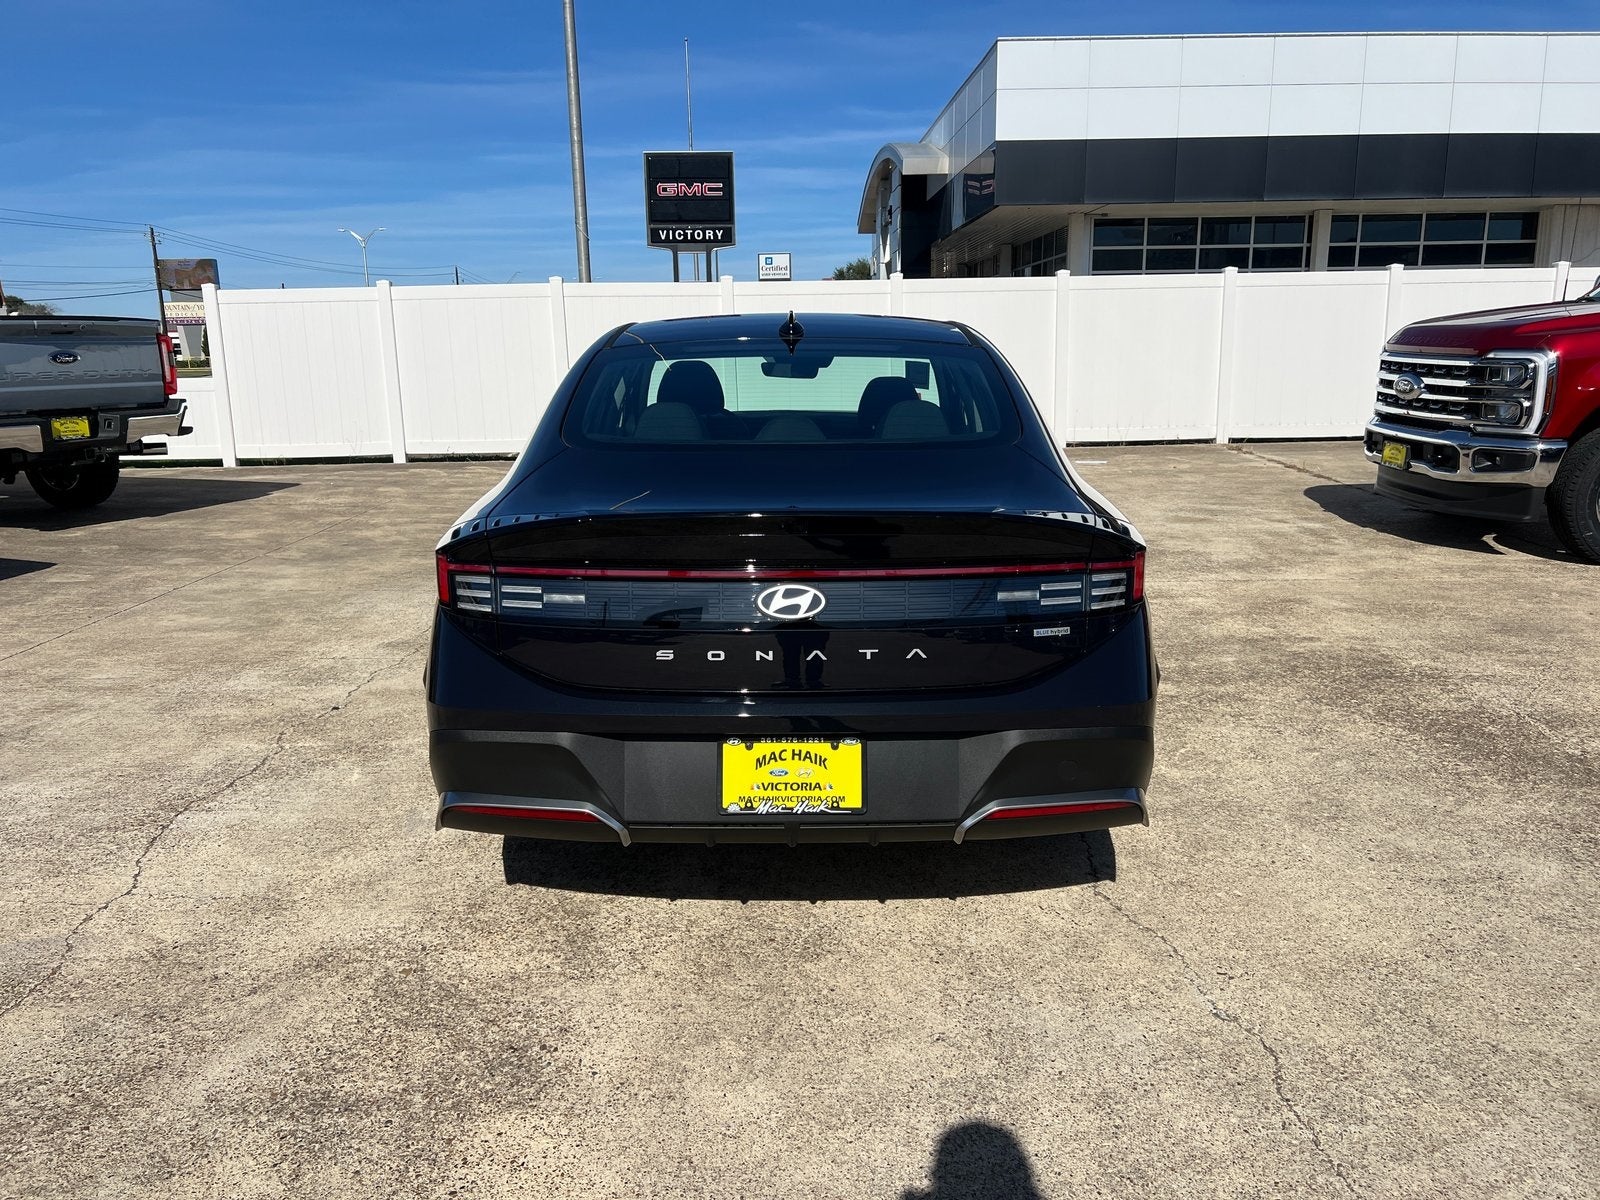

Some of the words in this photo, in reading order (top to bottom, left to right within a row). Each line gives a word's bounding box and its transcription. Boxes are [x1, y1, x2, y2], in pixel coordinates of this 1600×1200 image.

[656, 182, 723, 197] GMC
[658, 229, 724, 240] VICTORY
[0, 370, 76, 382] UPER
[82, 368, 153, 379] DUTY
[655, 648, 928, 661] SONATA
[755, 748, 788, 770] MAC
[791, 748, 829, 770] HAIK
[761, 782, 823, 792] VICTORIA
[738, 795, 846, 803] MACHAIKVICTORIA.COM
[755, 800, 788, 814] Mac
[793, 800, 831, 814] Haik
